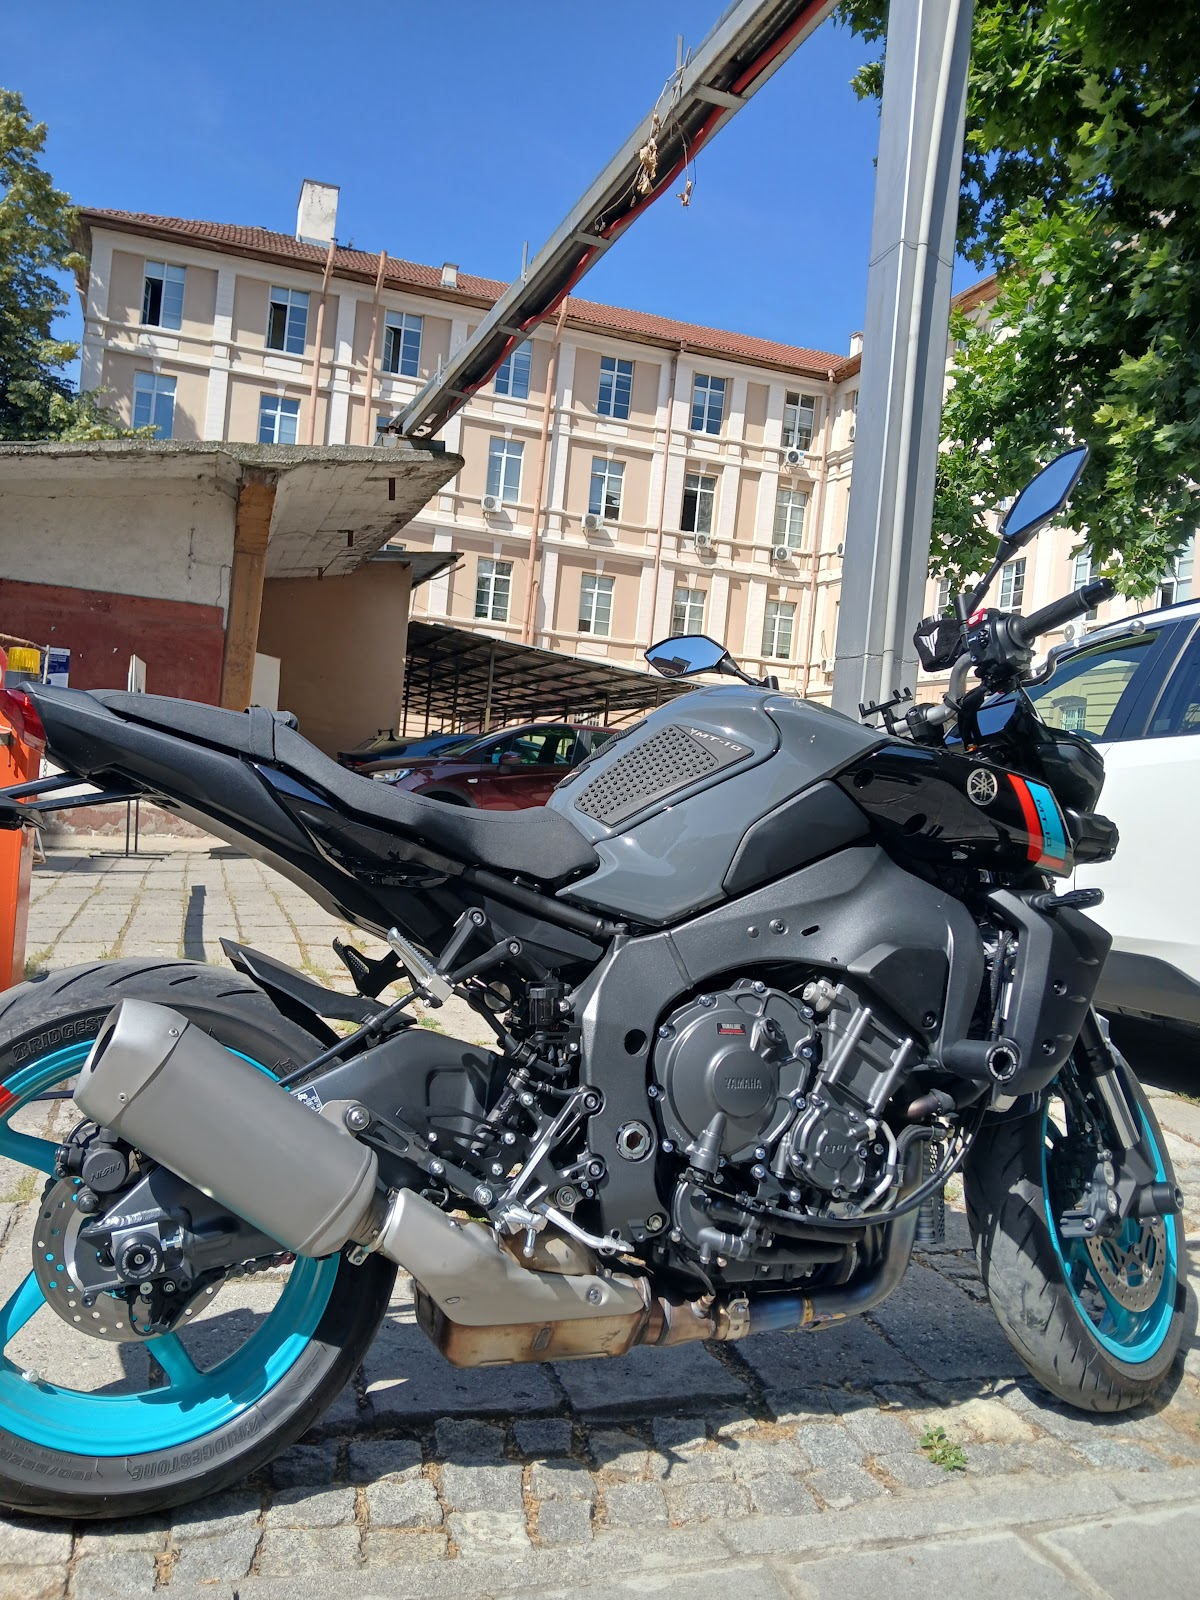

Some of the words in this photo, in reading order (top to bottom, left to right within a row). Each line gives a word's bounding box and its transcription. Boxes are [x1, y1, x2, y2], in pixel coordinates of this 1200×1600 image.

[1036, 799, 1052, 847] MT-10
[725, 1077, 762, 1090] YAMAHA
[131, 1414, 261, 1482] BRIDGESTONE
